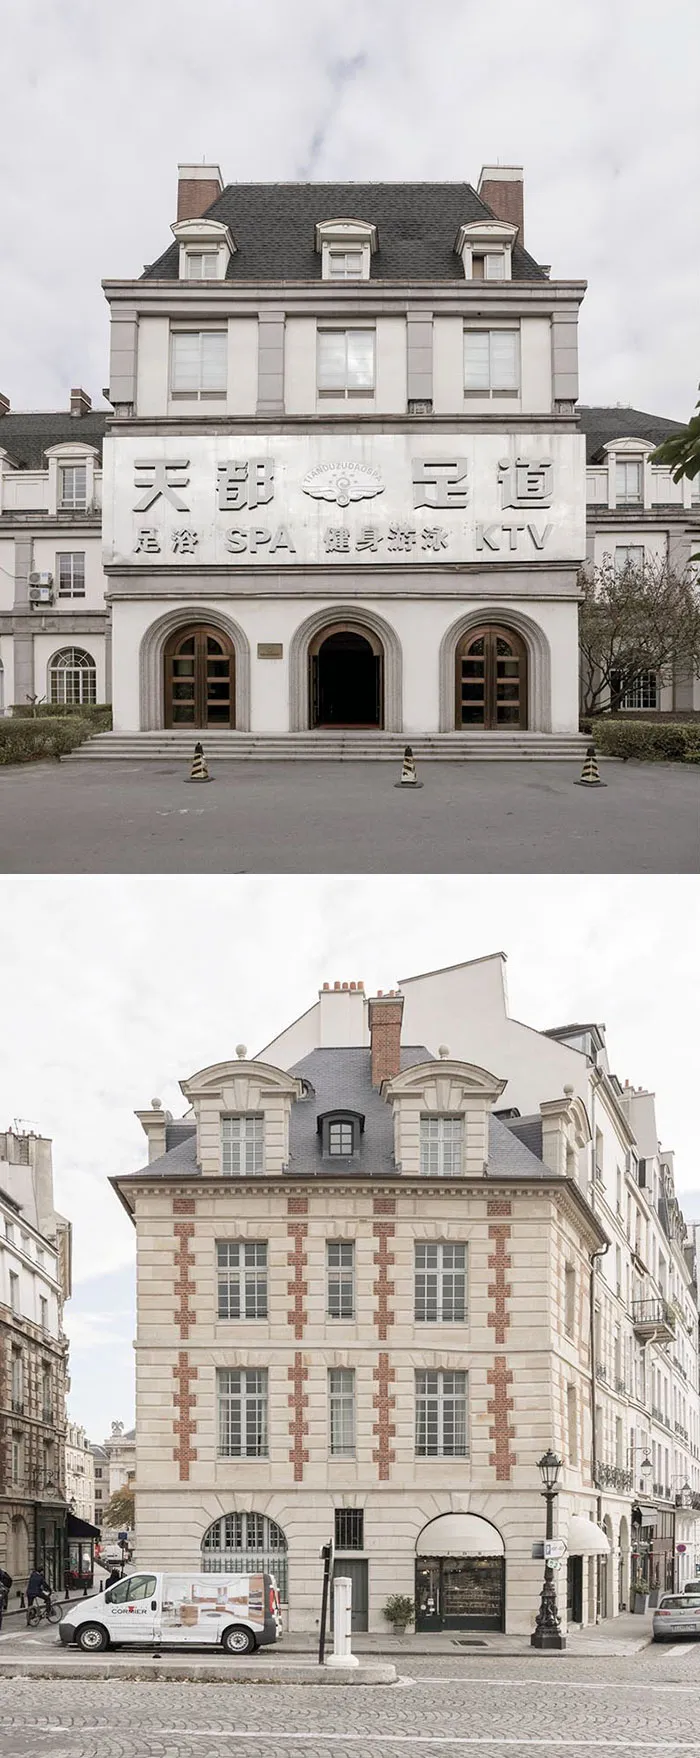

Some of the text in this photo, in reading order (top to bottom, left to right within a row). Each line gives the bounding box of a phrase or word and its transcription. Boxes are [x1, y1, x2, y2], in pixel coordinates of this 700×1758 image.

[132, 457, 553, 512] 天都 足道
[134, 524, 554, 554] 足浴 SPA 健身游泳 KTV
